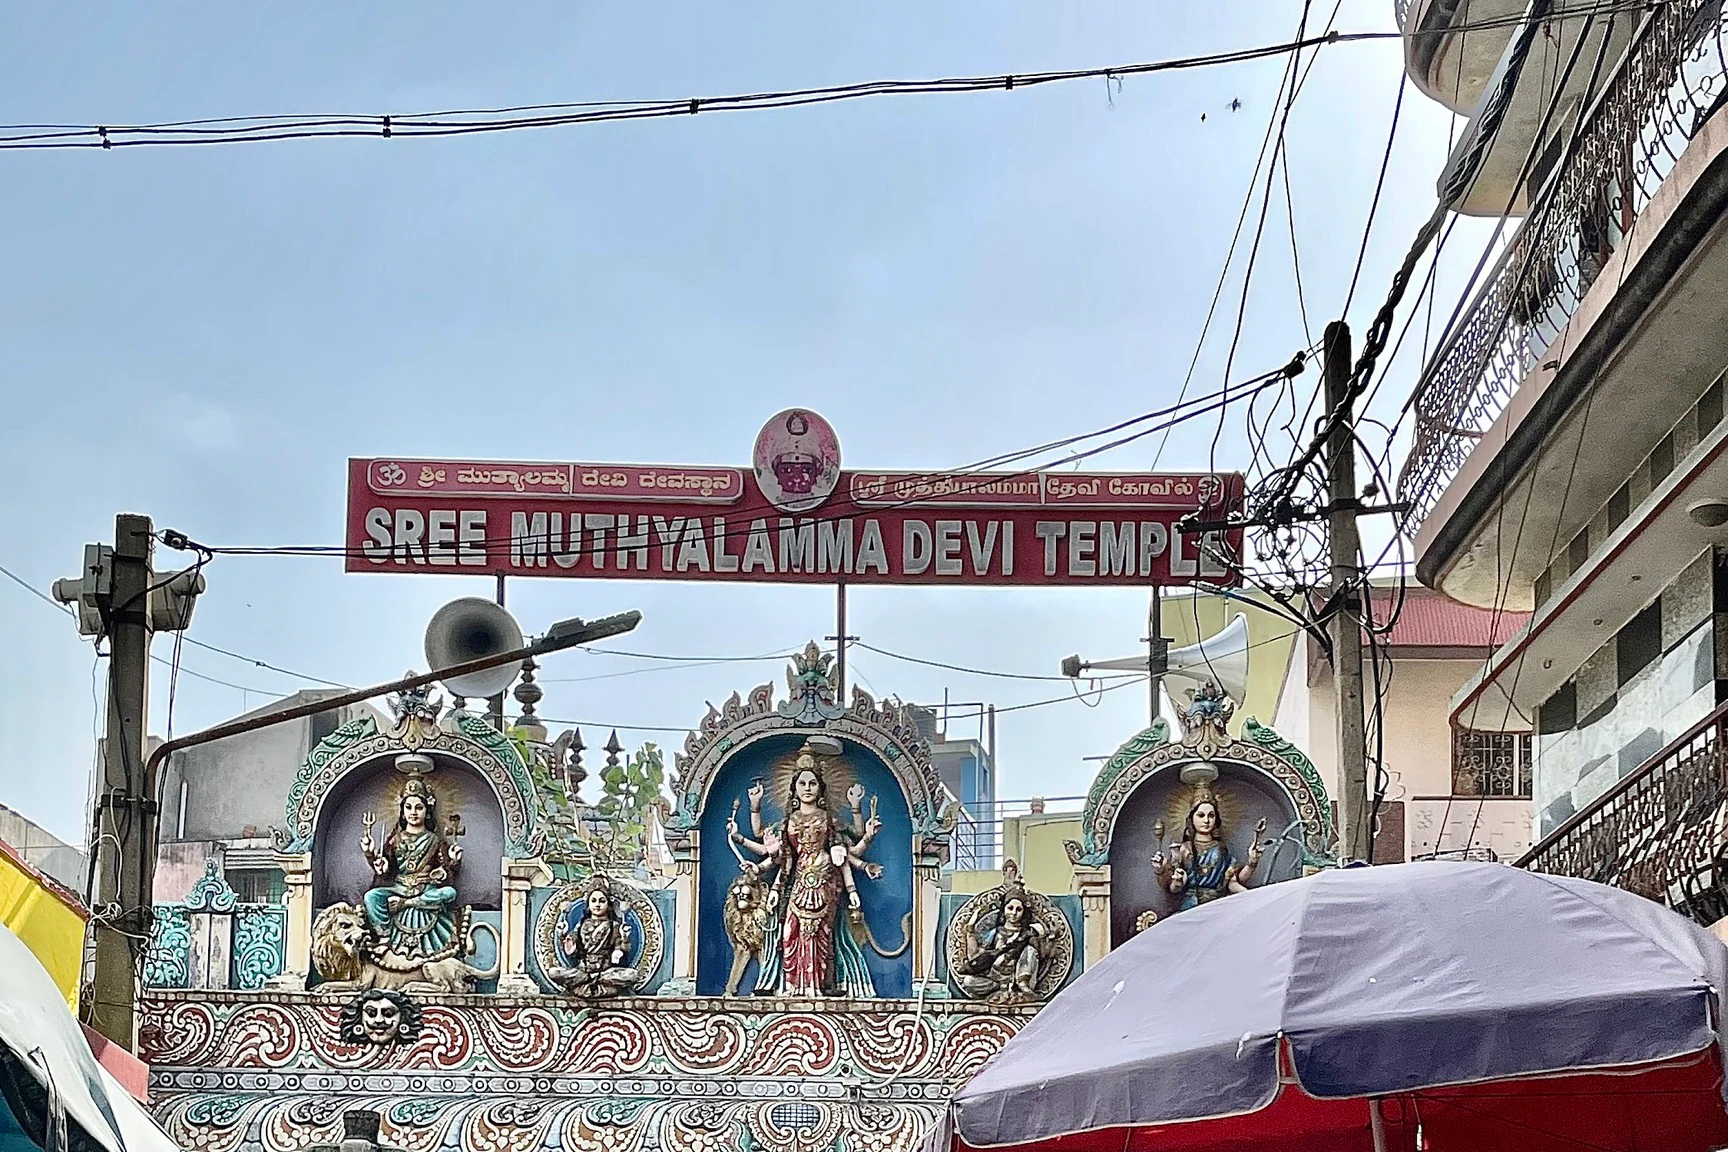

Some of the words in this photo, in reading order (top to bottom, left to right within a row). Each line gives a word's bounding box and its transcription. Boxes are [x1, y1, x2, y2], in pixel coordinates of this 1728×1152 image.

[417, 465, 446, 488] ಶ್ರೀ
[457, 466, 570, 493] ಮುತ್ಯಾಲಮ್ಮ
[581, 469, 628, 489] ದೇವಿ
[638, 471, 731, 498] ದೇವಸ್ಥಾನ
[1046, 478, 1101, 499] தேவி
[1108, 476, 1194, 496] கோவில்
[362, 506, 488, 568] SREE
[510, 511, 889, 575] MUTHYALAMMA
[902, 518, 1014, 577] DEVI
[1036, 520, 1228, 578] TEMPLE
